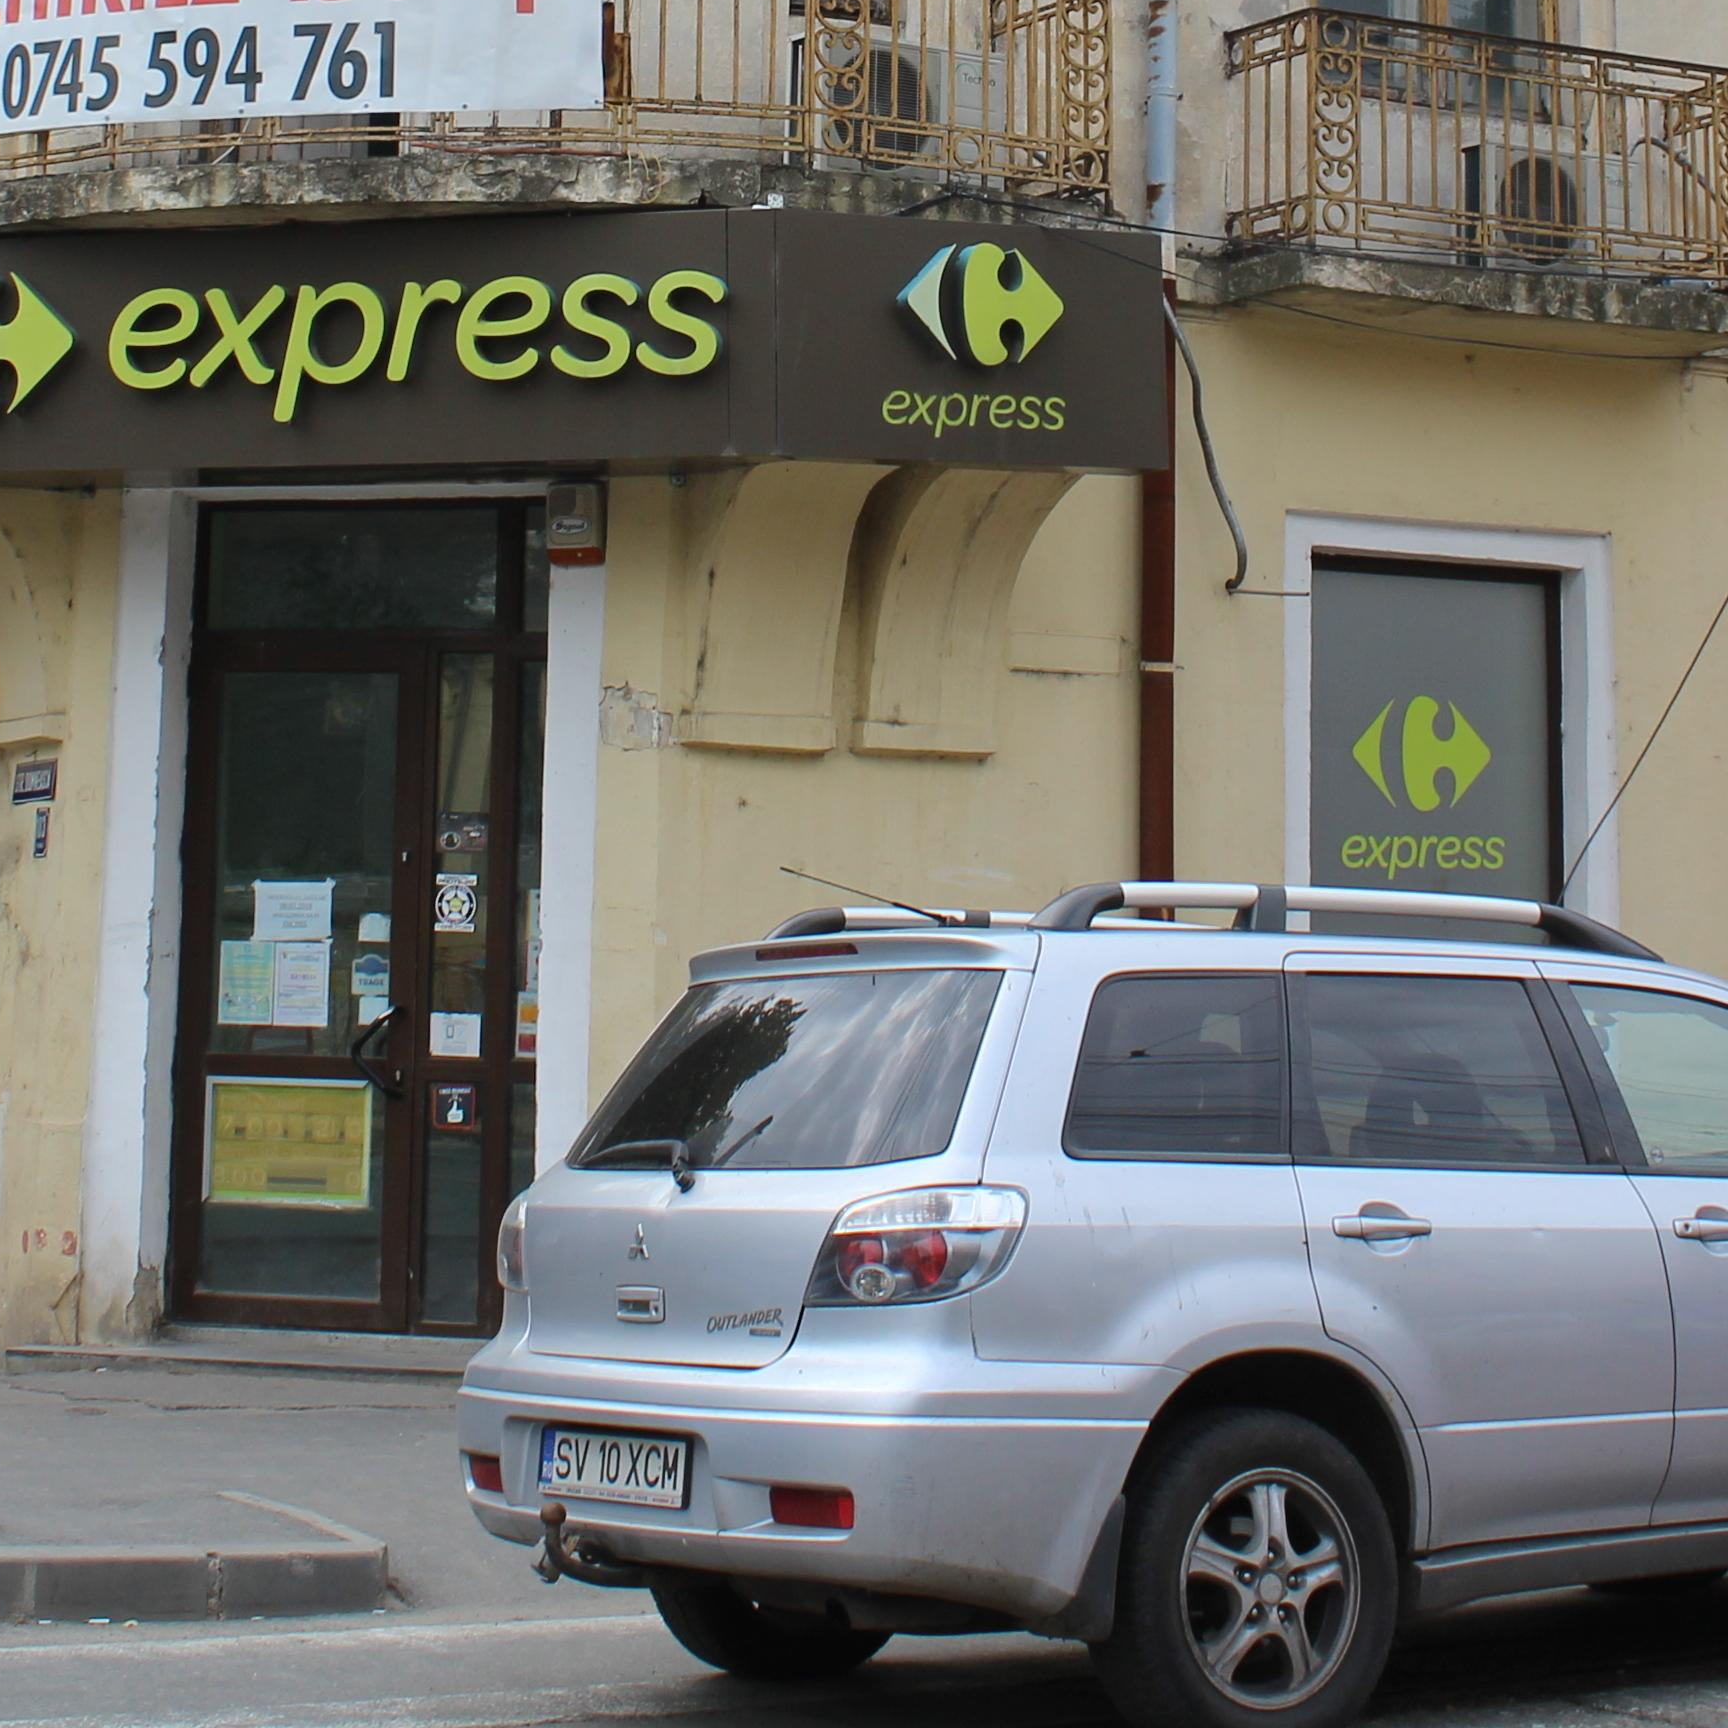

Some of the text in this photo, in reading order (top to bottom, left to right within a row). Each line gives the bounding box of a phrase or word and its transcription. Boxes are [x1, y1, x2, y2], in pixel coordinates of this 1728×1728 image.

[2, 21, 396, 120] 0745 594 761
[108, 270, 726, 423] express
[881, 389, 1066, 438] express
[1341, 833, 1506, 881] express
[706, 1308, 784, 1334] OUTLANDER
[555, 1436, 679, 1491] SV 10 XCM
